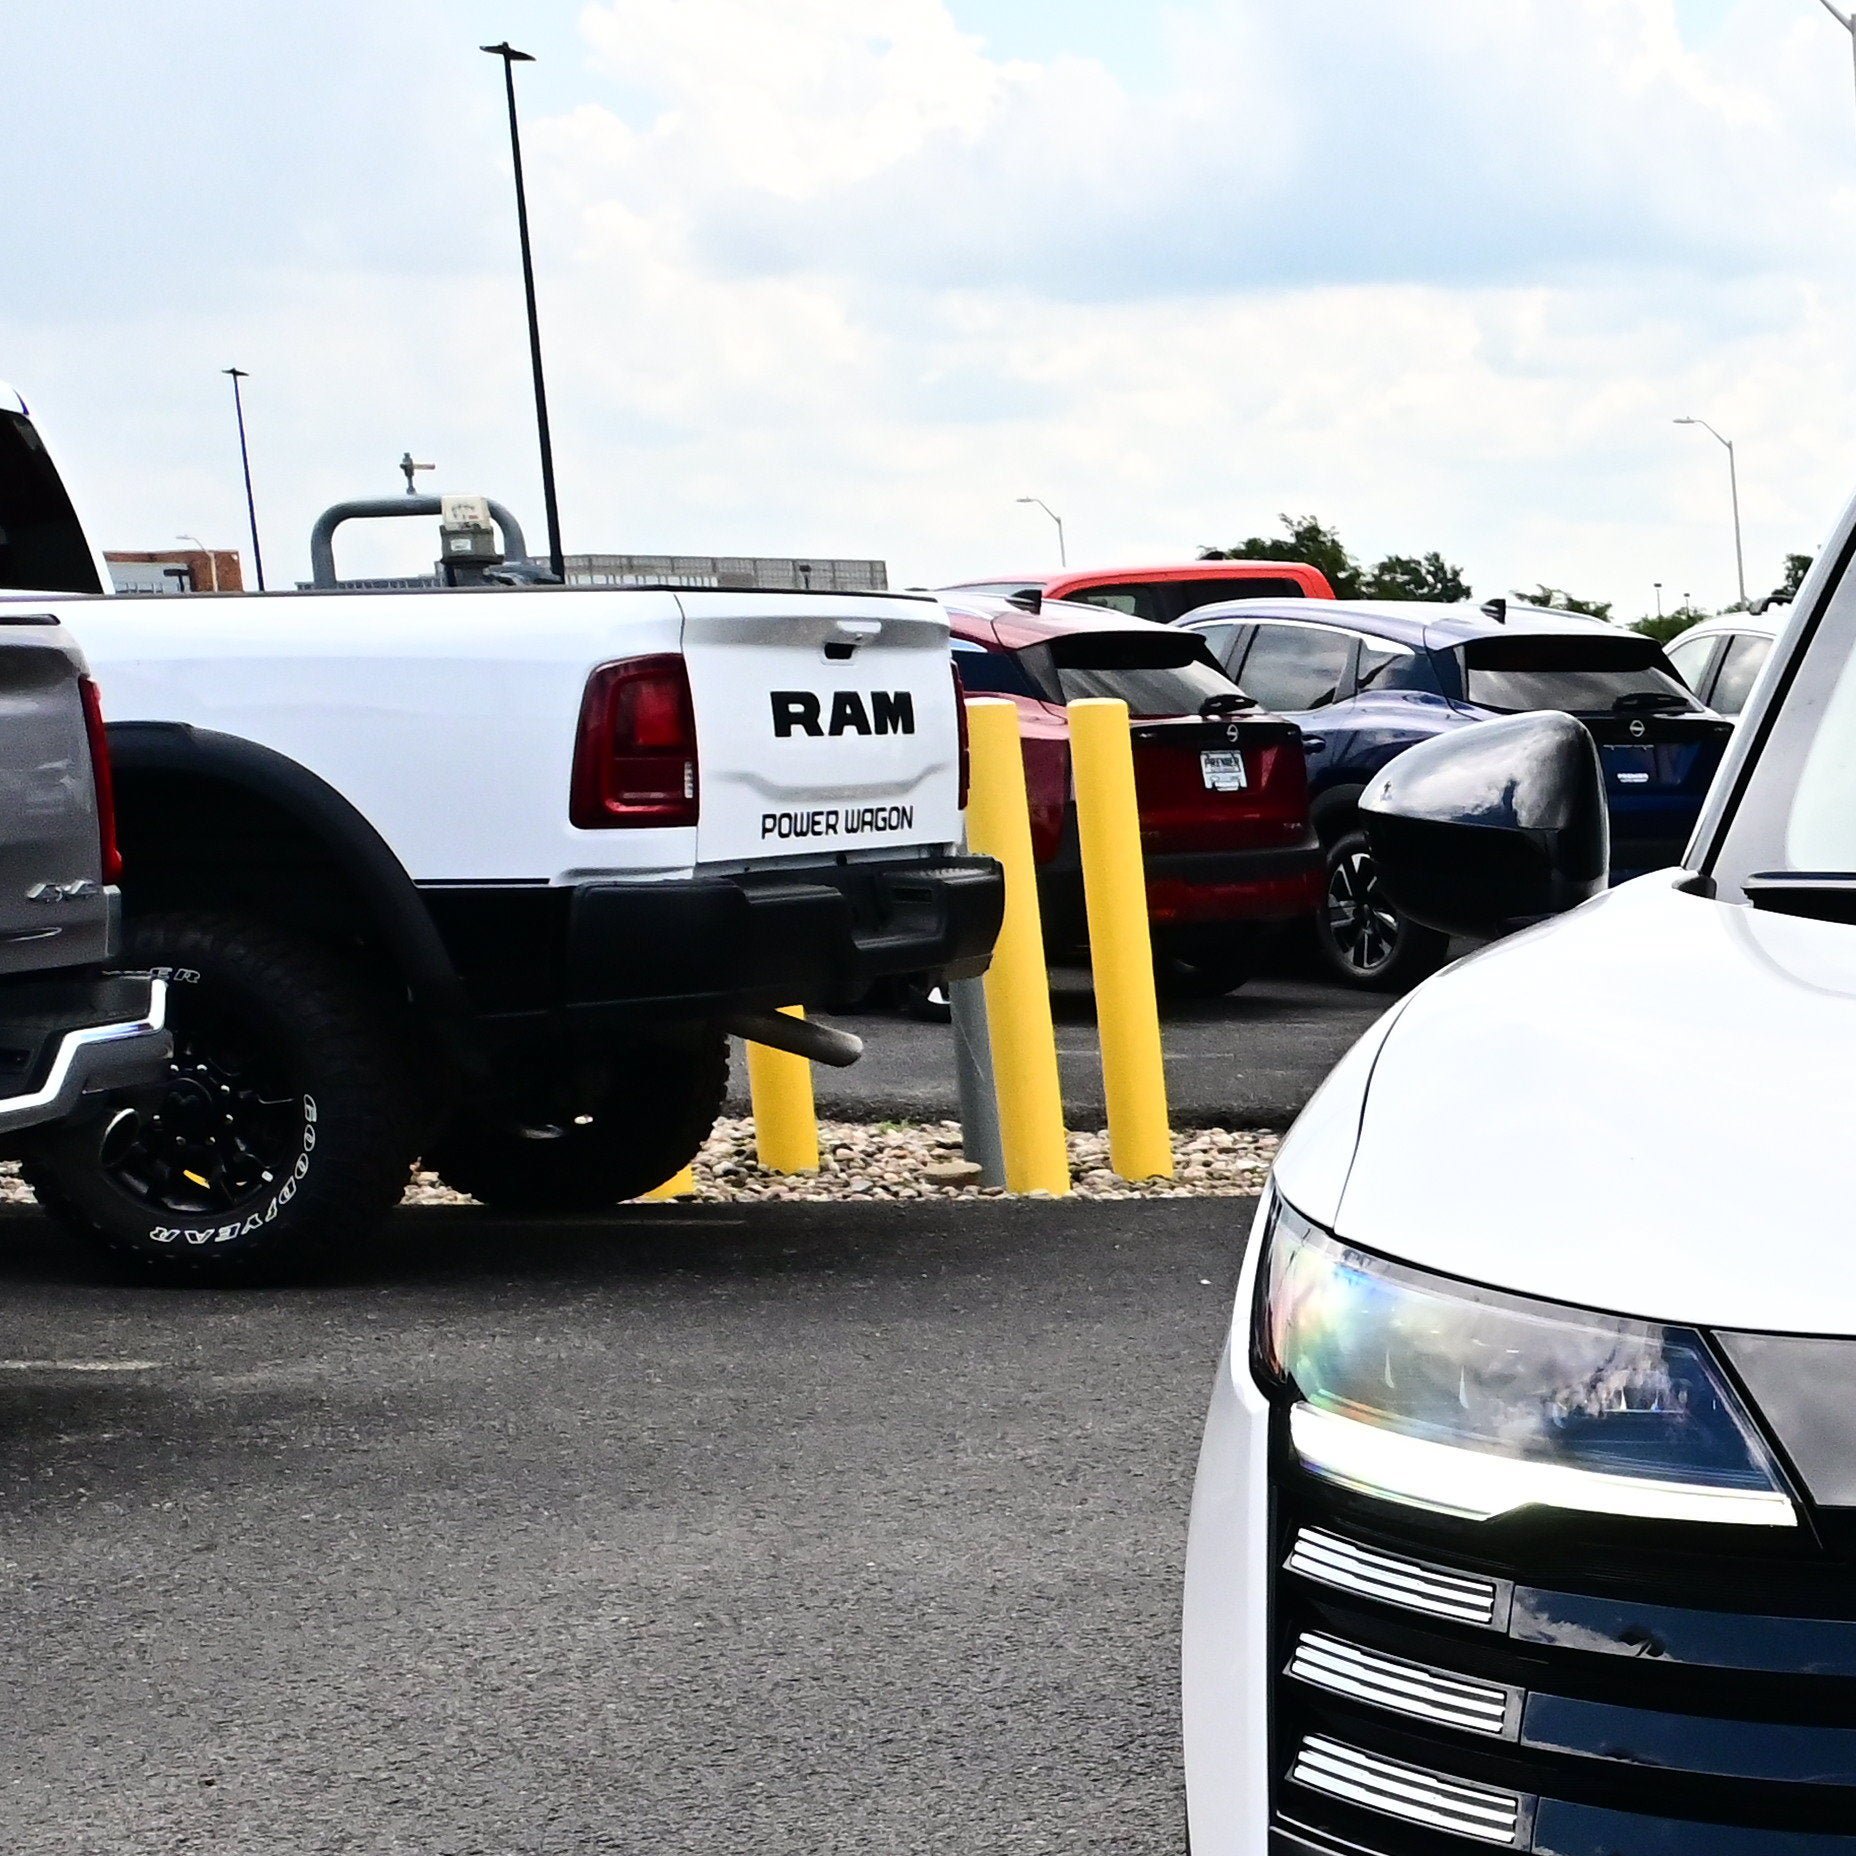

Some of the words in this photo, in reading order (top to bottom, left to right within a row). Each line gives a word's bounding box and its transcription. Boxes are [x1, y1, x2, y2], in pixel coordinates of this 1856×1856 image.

[770, 690, 915, 737] RAM
[761, 810, 839, 840] POWER
[845, 805, 914, 834] WAGON
[149, 1093, 317, 1244] GOODYEAR
